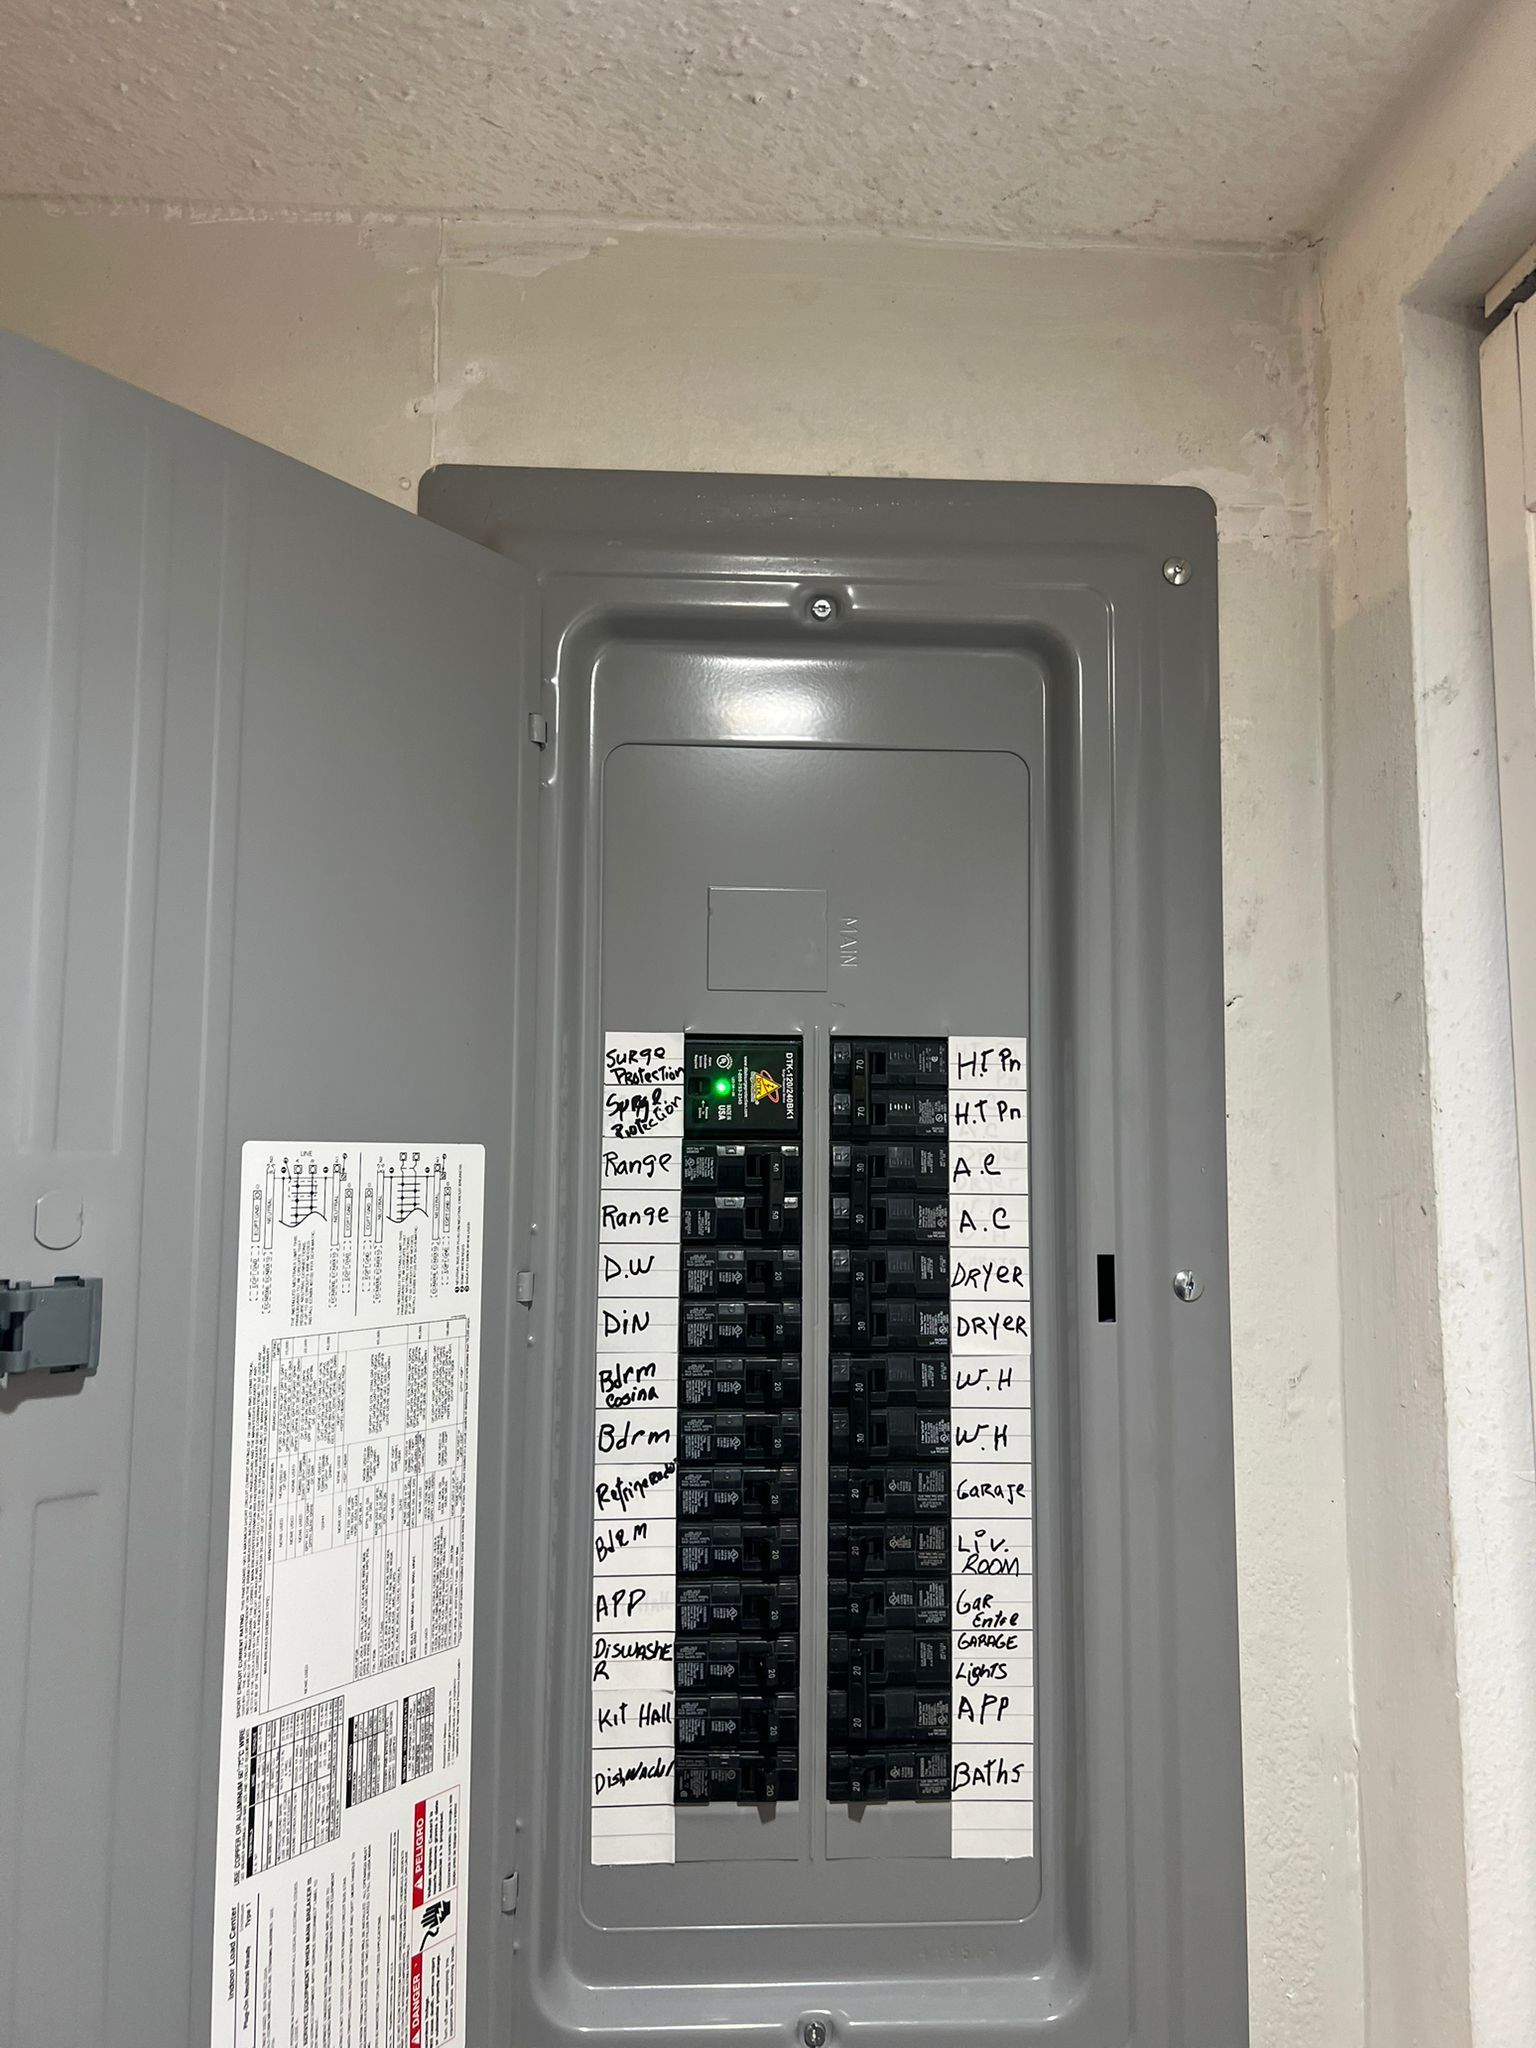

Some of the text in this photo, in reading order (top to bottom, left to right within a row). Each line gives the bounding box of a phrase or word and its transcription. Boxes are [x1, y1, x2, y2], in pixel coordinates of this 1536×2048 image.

[840, 917, 858, 968] MAIN
[856, 1059, 864, 1070] 70
[786, 1052, 794, 1120] DTK-120/240BK1
[718, 1105, 726, 1120] USA
[857, 1106, 865, 1117] 70
[603, 1151, 672, 1178] Range
[856, 1163, 864, 1173] 30
[602, 1204, 669, 1230] Range
[856, 1214, 864, 1224] 30
[775, 1272, 782, 1280] 20
[856, 1272, 864, 1281] 30
[776, 1324, 783, 1334] 20
[857, 1321, 866, 1331] 30
[774, 1382, 782, 1391] 20
[855, 1383, 863, 1392] 30
[598, 1420, 670, 1453] Bdrm
[856, 1433, 864, 1443] 30
[774, 1439, 782, 1449] 20
[852, 1489, 859, 1498] 20
[771, 1495, 778, 1504] 20
[772, 1550, 779, 1560] 20
[852, 1546, 859, 1556] 20
[596, 1588, 646, 1623] APP
[851, 1603, 859, 1613] 20
[771, 1610, 778, 1620] 20
[957, 1632, 1018, 1650] GARAGE
[593, 1660, 610, 1682] R
[768, 1668, 775, 1679] 20
[853, 1665, 861, 1675] 20
[853, 1718, 862, 1728] 20
[770, 1726, 777, 1736] 20
[238, 1728, 246, 1748] WIRE
[766, 1785, 774, 1796] 20
[852, 1782, 860, 1792] 20
[235, 1782, 244, 1821] ALUMINUM
[235, 1824, 242, 1835] OR
[415, 1818, 425, 1874] PELIGRO
[234, 1837, 242, 1869] COPPER
[228, 1907, 237, 1940] Center
[228, 1942, 236, 1966] Load
[412, 1973, 421, 2028] DANGER
